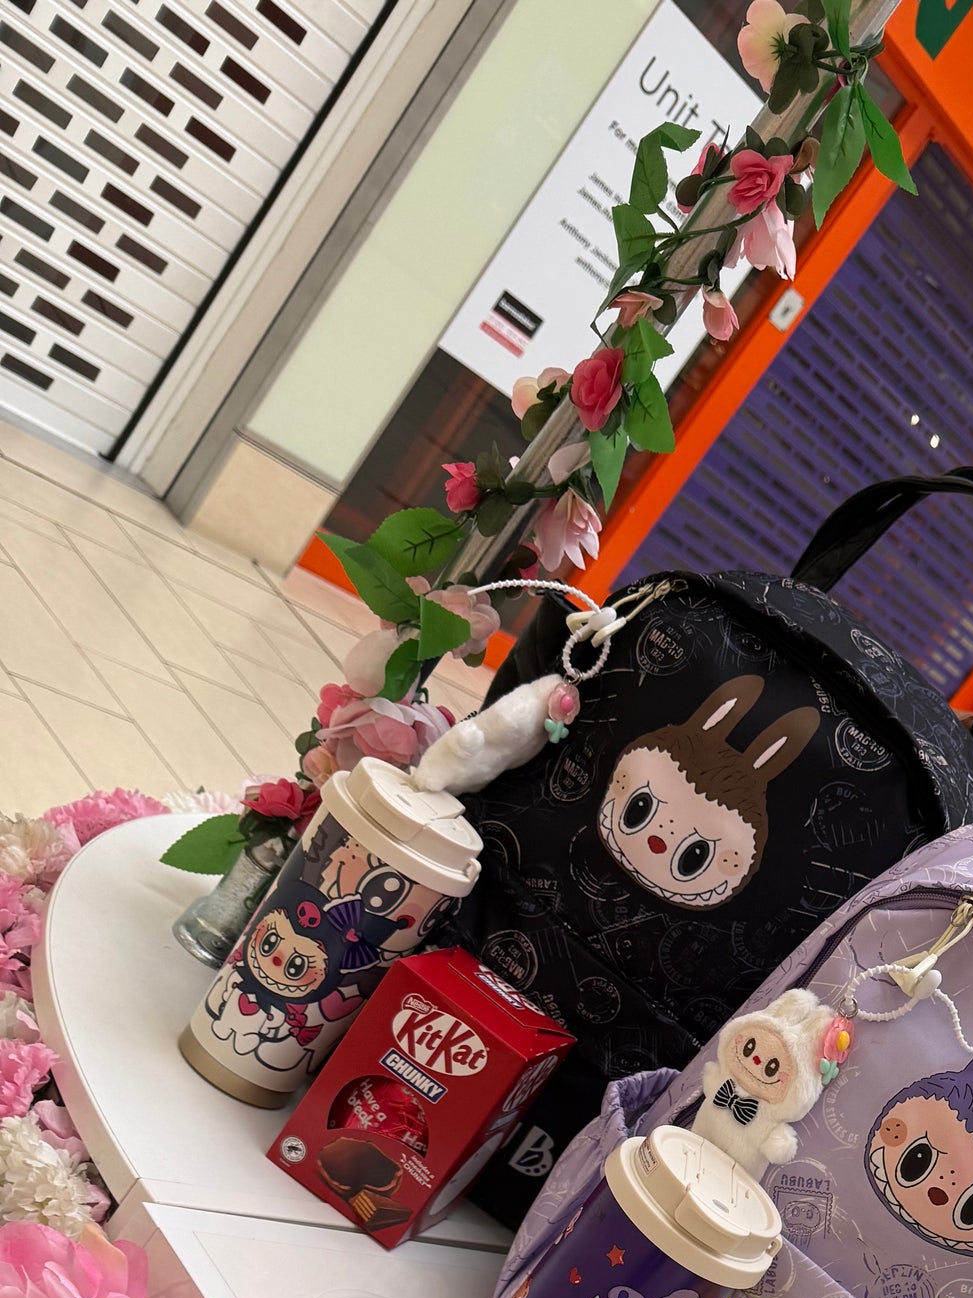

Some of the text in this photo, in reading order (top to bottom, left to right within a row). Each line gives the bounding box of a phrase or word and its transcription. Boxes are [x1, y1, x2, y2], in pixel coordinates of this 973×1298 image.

[638, 55, 699, 128] Unit
[396, 1009, 487, 1075] KitKat
[359, 1078, 380, 1112] Have
[385, 1053, 443, 1100] CHUNKY
[780, 1173, 830, 1191] LABUBU
